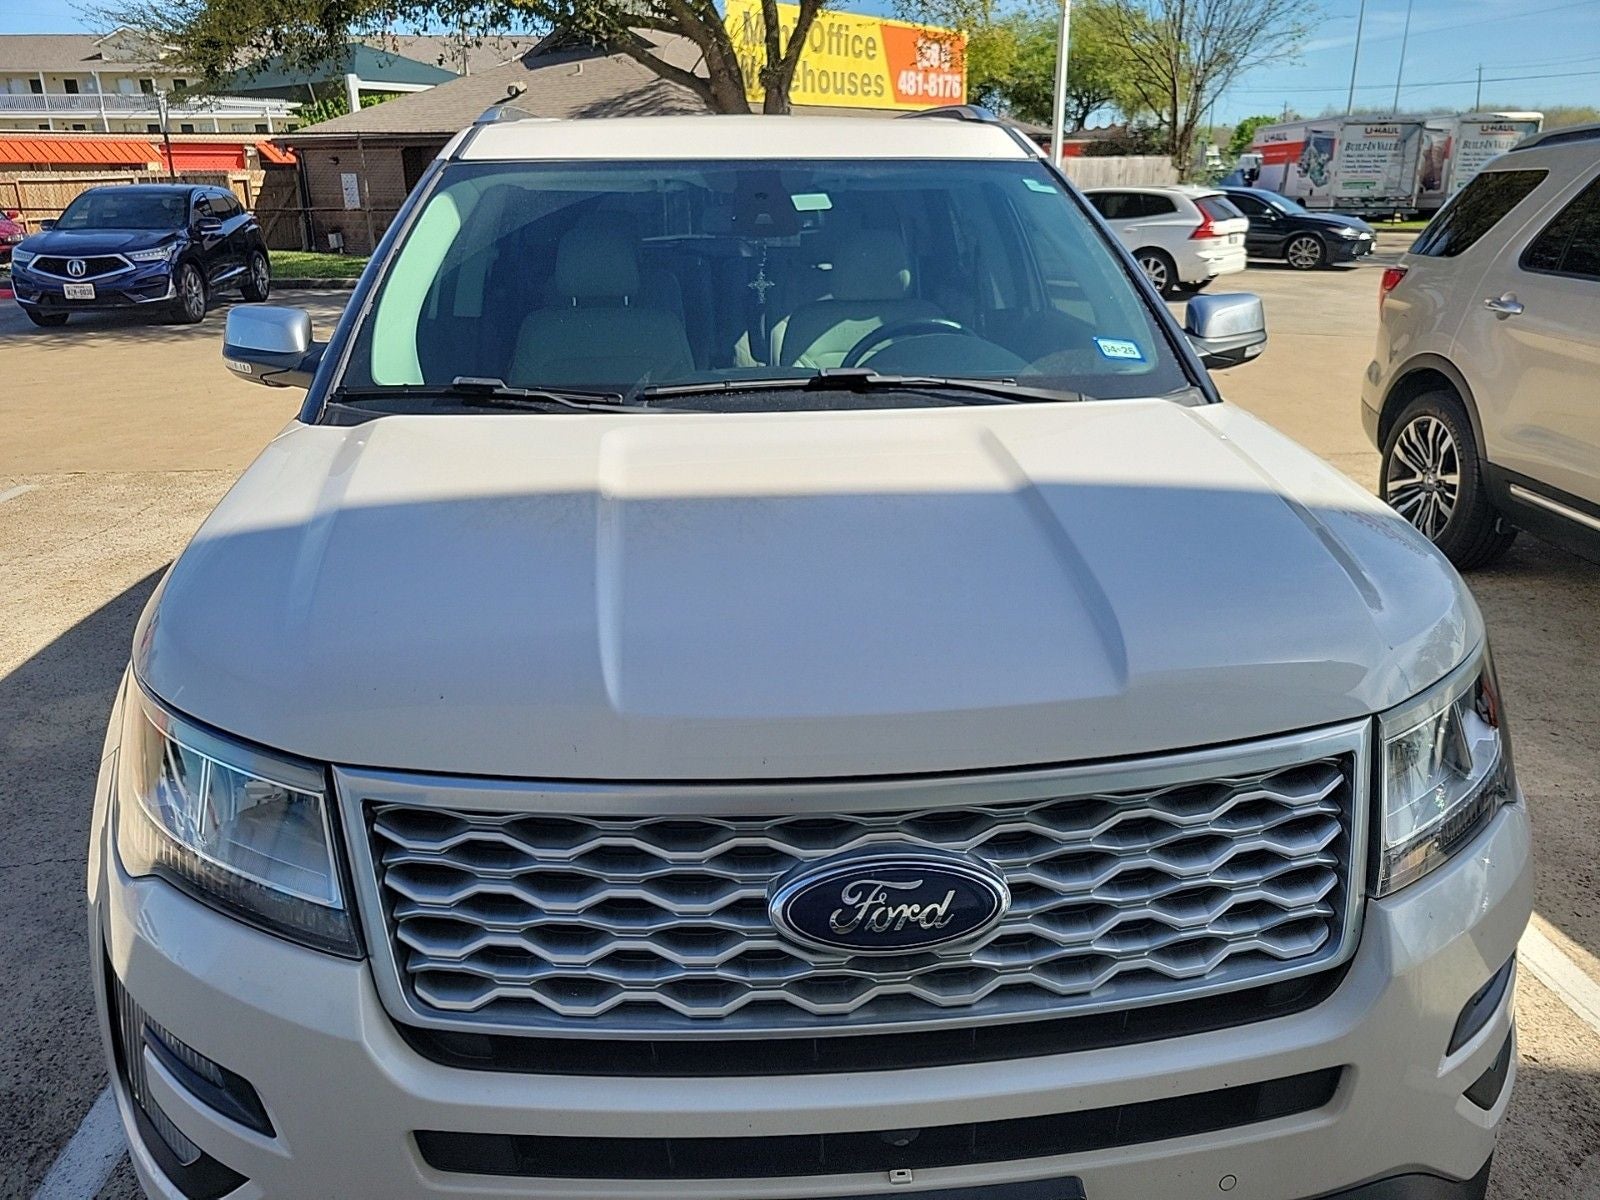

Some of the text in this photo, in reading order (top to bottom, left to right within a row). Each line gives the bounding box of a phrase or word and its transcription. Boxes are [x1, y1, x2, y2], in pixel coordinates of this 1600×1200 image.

[808, 20, 877, 60] Office
[898, 69, 961, 98] 481-8176
[829, 879, 955, 935] Ford
